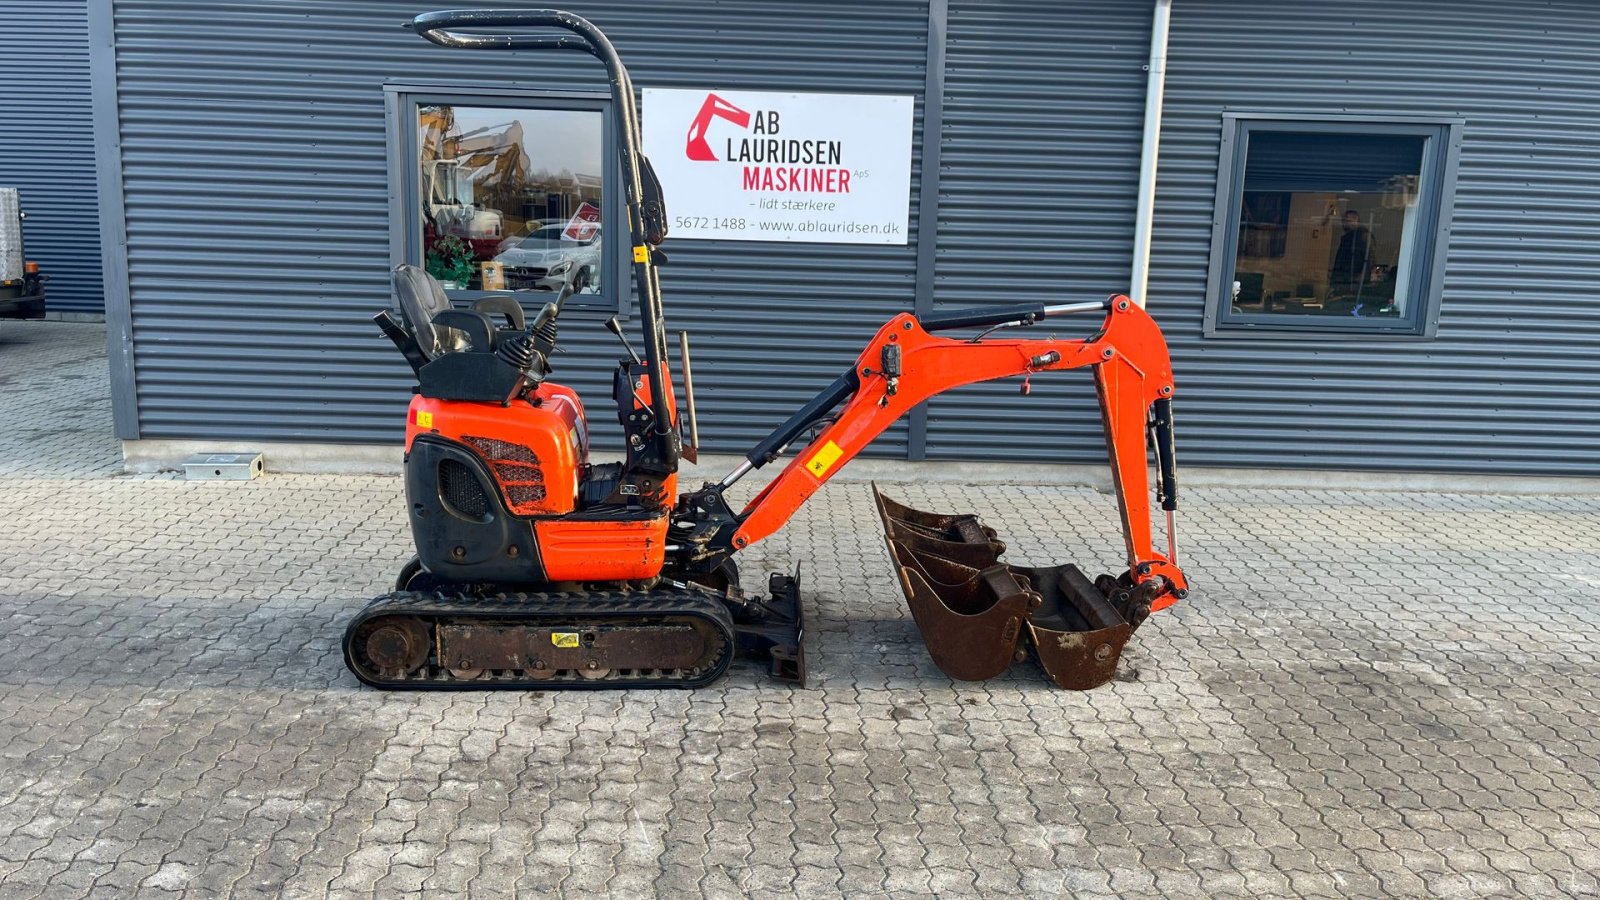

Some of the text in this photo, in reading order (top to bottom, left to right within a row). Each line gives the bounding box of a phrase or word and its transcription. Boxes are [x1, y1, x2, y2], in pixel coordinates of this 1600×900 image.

[753, 110, 779, 135] AB
[727, 138, 841, 165] LAURIDSEN
[743, 166, 870, 193] MASKINER ApS
[759, 198, 779, 210] lidt
[781, 200, 836, 212] stærkere
[676, 217, 709, 229] 5672
[713, 218, 746, 230] 1488
[759, 219, 900, 234] www.ablauridsen.dk
